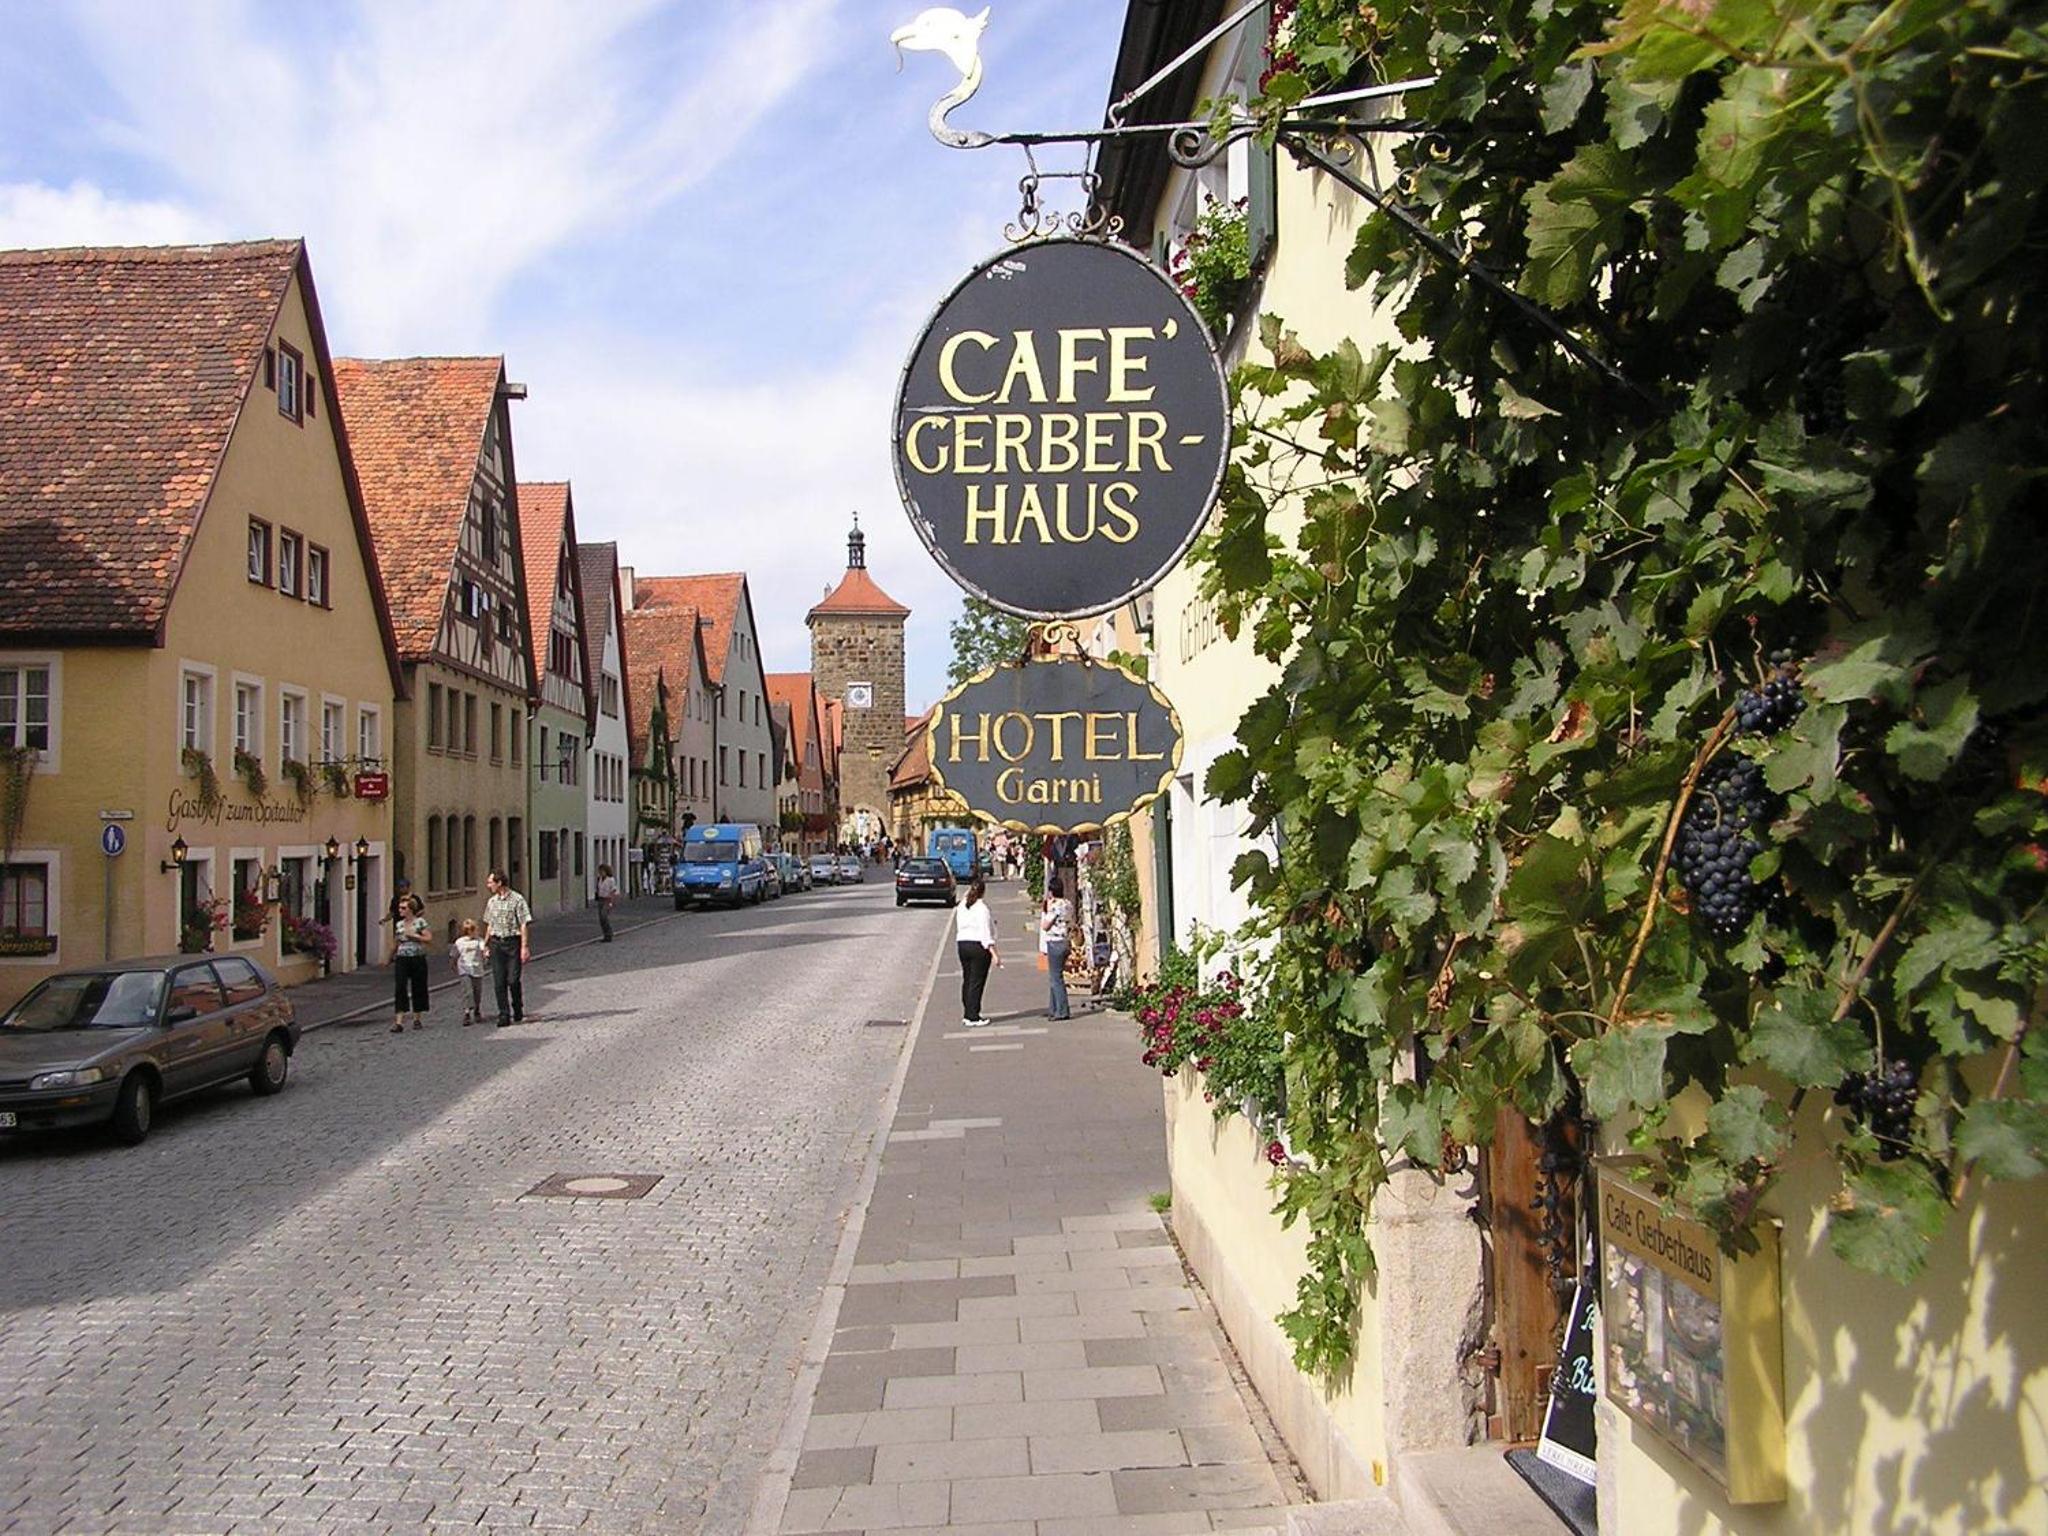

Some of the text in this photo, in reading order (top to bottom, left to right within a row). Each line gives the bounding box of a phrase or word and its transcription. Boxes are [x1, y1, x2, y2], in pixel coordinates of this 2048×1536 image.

[905, 411, 1205, 475] GERBER-
[963, 481, 1141, 545] HAUS
[948, 711, 1165, 763] HOTEL
[226, 803, 253, 822] zum
[996, 767, 1103, 805] Garni
[1605, 1193, 1713, 1284] Cafe Gerberhaus
